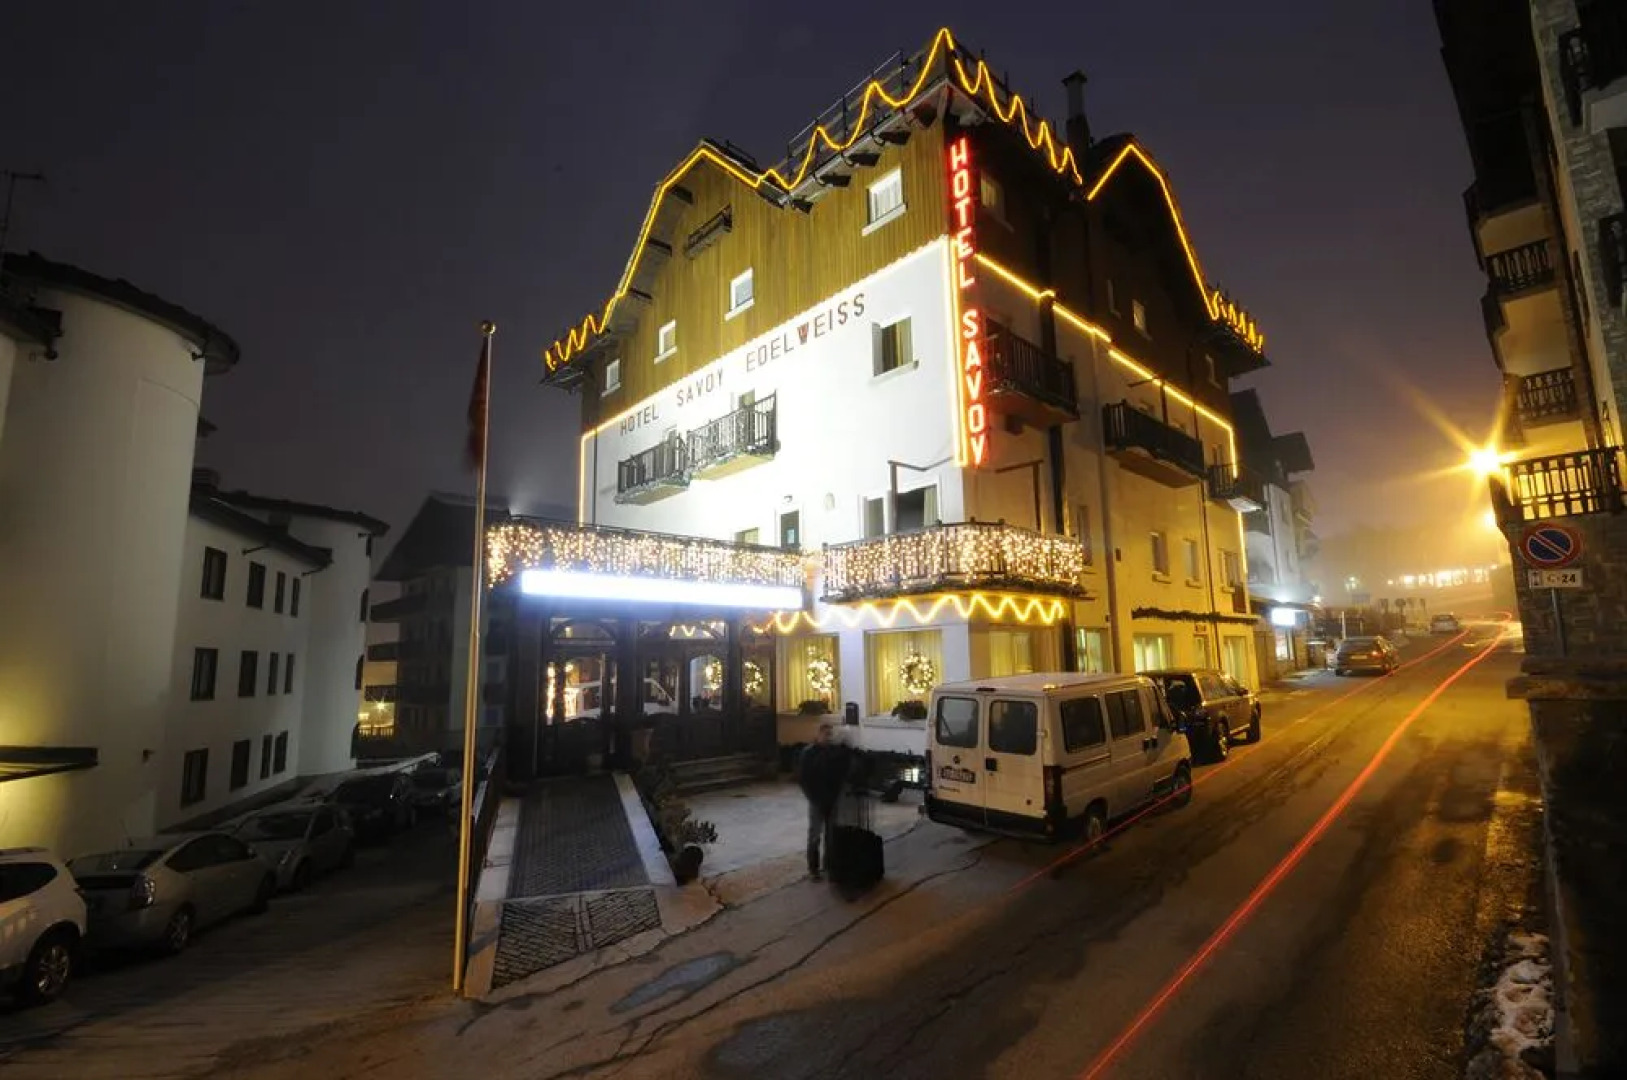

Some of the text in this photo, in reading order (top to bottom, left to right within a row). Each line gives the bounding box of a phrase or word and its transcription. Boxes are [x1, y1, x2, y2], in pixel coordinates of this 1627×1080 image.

[620, 293, 866, 436] HOTEL SAVOY EDELWEISS
[951, 138, 985, 465] HOTEL SAVOY
